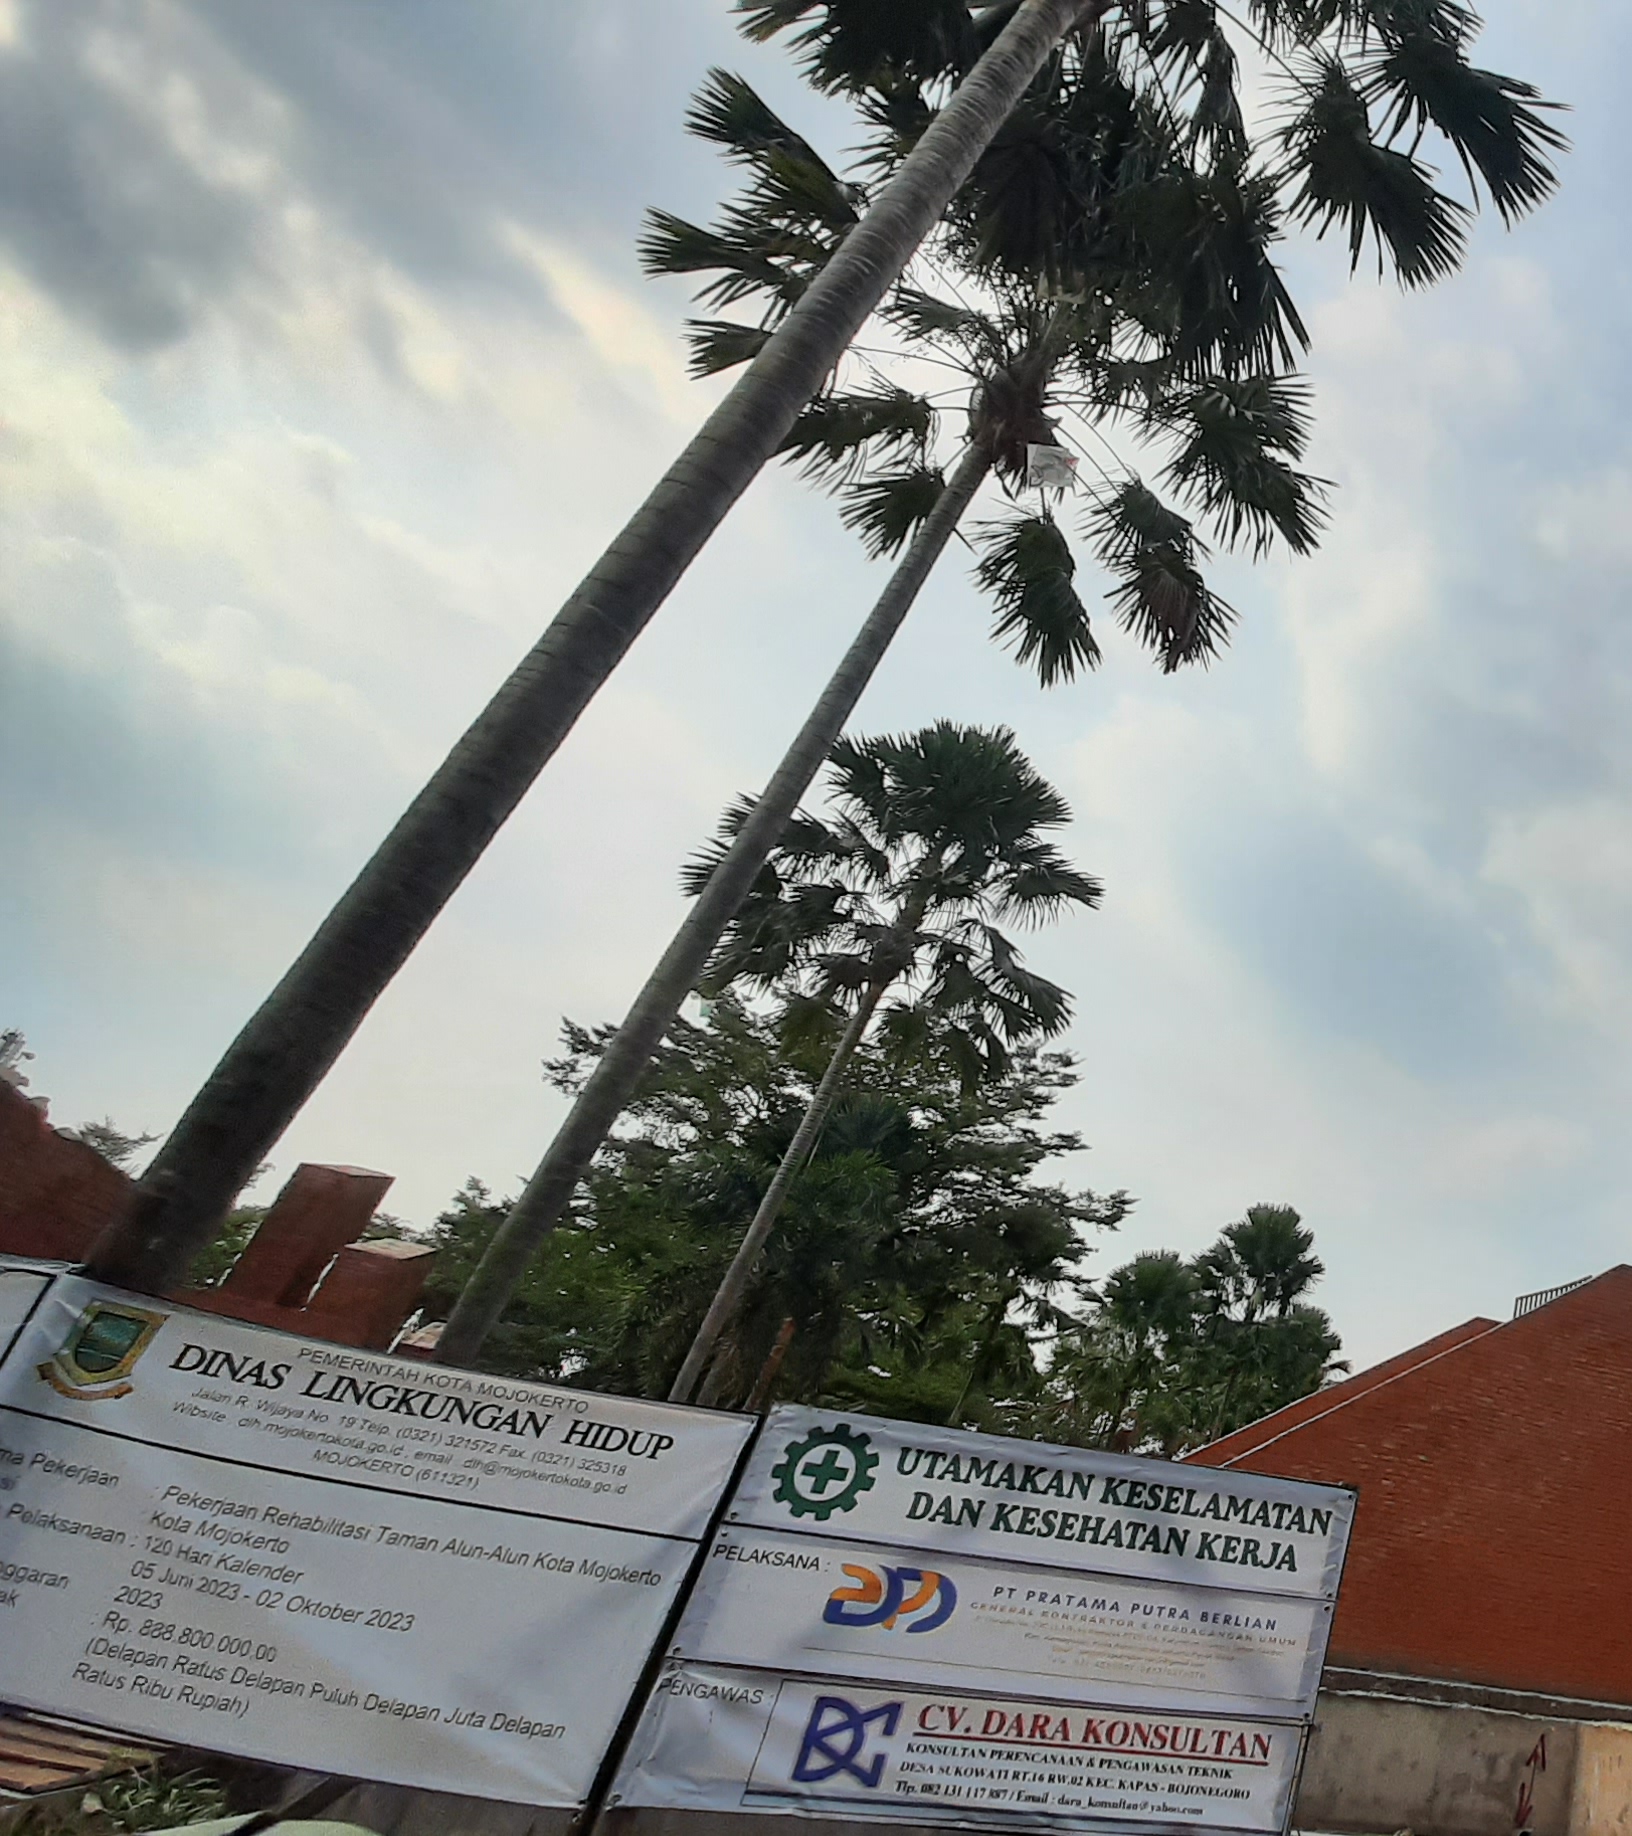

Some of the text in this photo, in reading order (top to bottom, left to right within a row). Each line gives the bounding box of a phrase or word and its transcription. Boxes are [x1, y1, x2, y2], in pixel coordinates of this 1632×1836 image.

[168, 1343, 674, 1460] DINAS LINGKUNGAN HIDUP
[298, 1347, 589, 1413] PEMERINTAH KOTA MOJOKERTO
[192, 1387, 231, 1403] Jalan
[256, 1399, 305, 1419] Wijaya
[339, 1415, 356, 1429] 19
[396, 1427, 443, 1446] (0321)
[445, 1435, 497, 1454] 321572
[531, 1451, 575, 1468] (0321)
[577, 1458, 627, 1476] 325318
[30, 1452, 120, 1487] Pekerjaan
[313, 1449, 480, 1491] MOJOKERTO (611321)
[414, 1450, 453, 1465] email
[897, 1446, 1334, 1537] UTAMAKAN KESELAMATAN
[7, 1503, 126, 1545] Pelaksanaan
[144, 1535, 174, 1557] 120
[175, 1542, 213, 1566] Hari
[216, 1552, 304, 1584] Kalender
[149, 1510, 291, 1555] Kota Mojokerto
[161, 1485, 662, 1587] Pekerjaan Rehabilitasi Taman Alun-Alun Kota Mojokerto
[906, 1491, 1298, 1573] DAN KESEHATAN KERJA
[712, 1544, 821, 1571] PELAKSANA
[113, 1585, 164, 1610] 2023
[130, 1560, 156, 1579] 05
[158, 1568, 195, 1588] Juni
[196, 1576, 242, 1601] 2023
[255, 1589, 284, 1609] 02
[286, 1595, 364, 1624] Oktober
[364, 1608, 416, 1632] 2023
[993, 1586, 1278, 1631] PT PRATAMA PUTRA BERLIAN
[102, 1610, 132, 1635] Rp.
[970, 1601, 1034, 1616] GENERAL
[1041, 1610, 1135, 1628] KONTRAKTOR
[1154, 1623, 1253, 1643] PERDAGANGAN
[1259, 1637, 1297, 1646] UMUM
[71, 1662, 250, 1719] Ratus Ribu Rupiah)
[84, 1637, 567, 1740] (Delapan Ratus Delapan Puluh Delapan Juta Delapan
[656, 1677, 764, 1704] PENGAWAS
[917, 1703, 1273, 1760] CV. DARA KONSULTAN
[900, 1761, 934, 1774] DESA
[938, 1766, 1009, 1781] SUKOWATI
[1011, 1770, 1045, 1783] RT.16
[1047, 1773, 1084, 1787] RW.02
[1117, 1779, 1159, 1793] KAPAS
[1167, 1784, 1251, 1800] BOJONEGORO
[906, 1742, 1234, 1779] KONSULTAN PERENCANAAN & PENGAWASAN TEKNIK
[1016, 1790, 1050, 1804] Email
